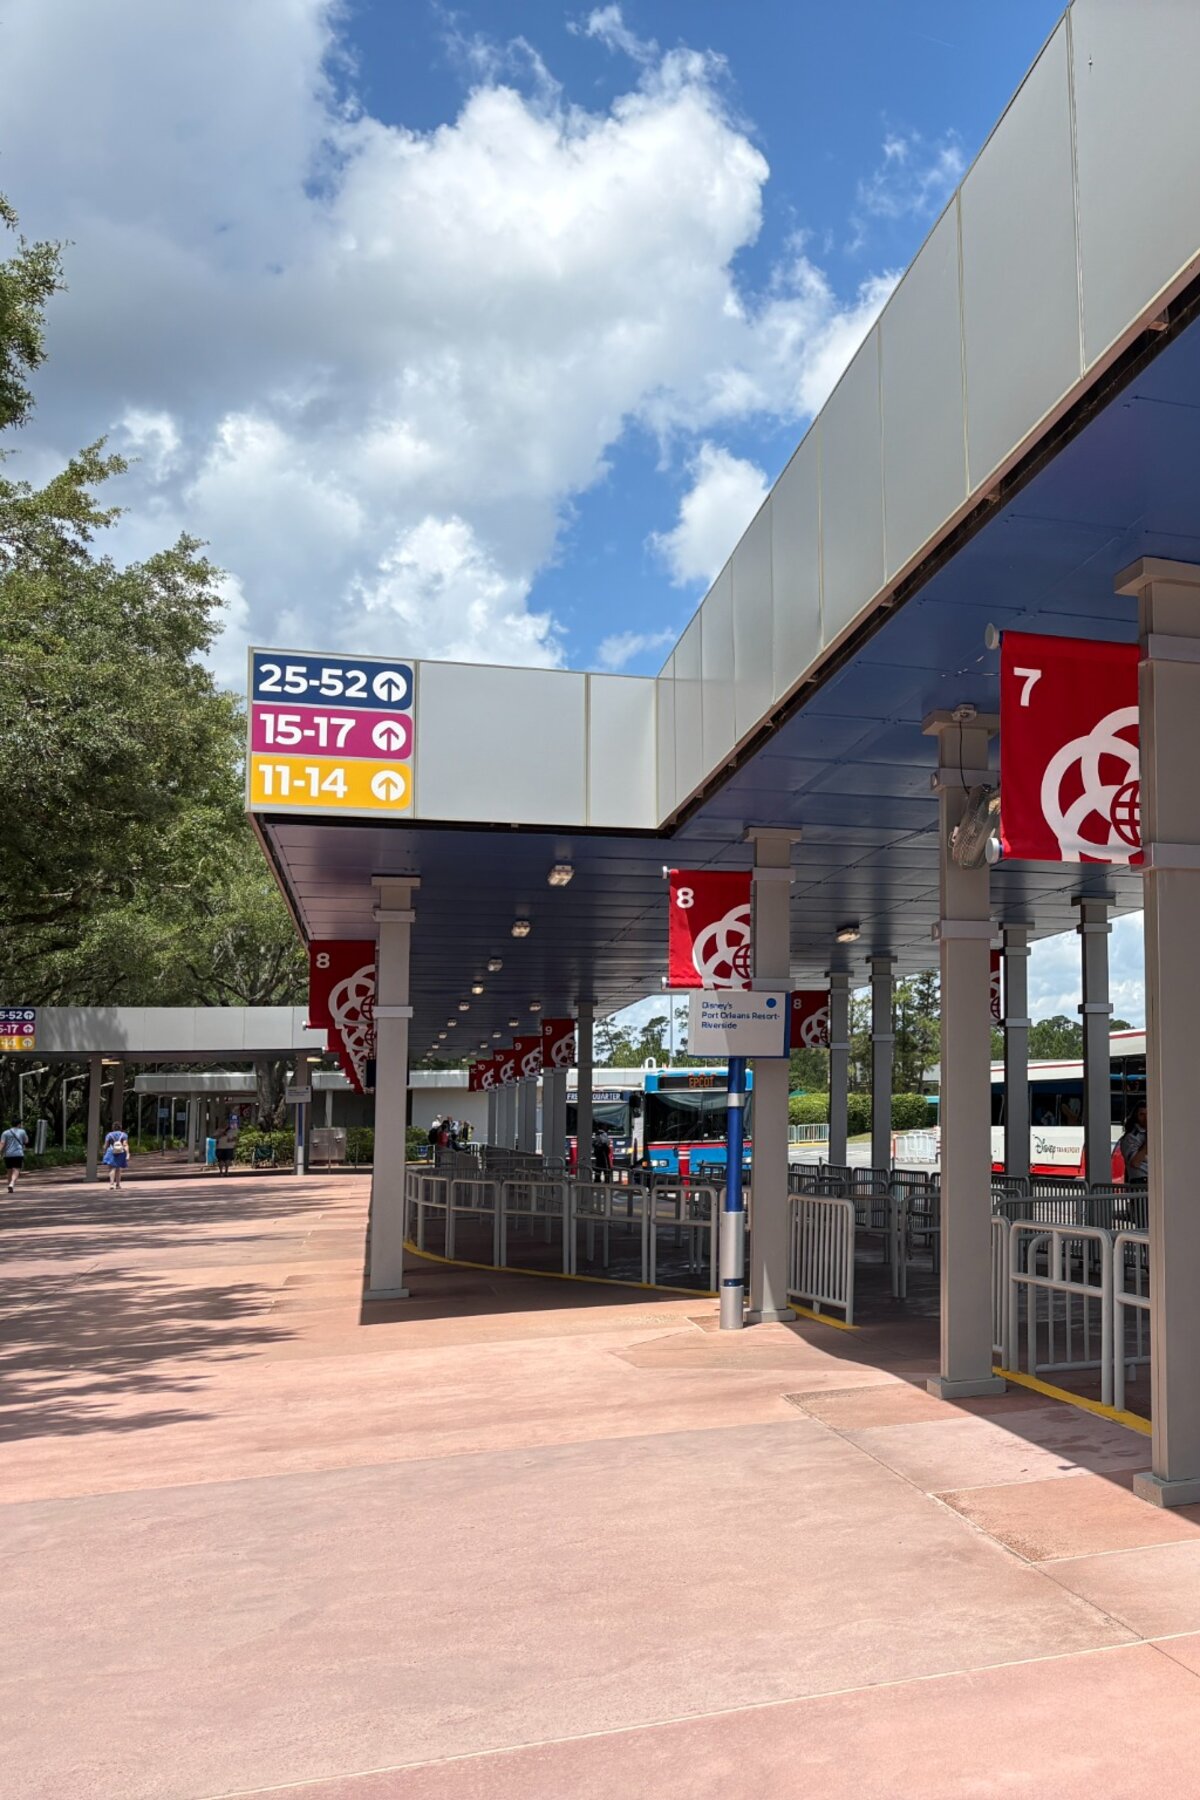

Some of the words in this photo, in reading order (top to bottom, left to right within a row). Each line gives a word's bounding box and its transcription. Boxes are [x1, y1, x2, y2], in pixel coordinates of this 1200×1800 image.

[258, 663, 368, 698] 25-52
[1013, 666, 1042, 707] 7
[259, 713, 356, 748] 15-17
[258, 764, 348, 798] 11-14
[676, 887, 695, 909] 8
[315, 952, 331, 969] 8
[702, 1001, 733, 1010] Disney's
[793, 998, 802, 1010] 8
[0, 1010, 23, 1020] 5-52
[702, 1011, 719, 1019] Port
[720, 1011, 751, 1019] Orleans
[545, 1026, 553, 1035] 9
[702, 1021, 738, 1029] Riverside
[688, 1077, 715, 1088] EPCOT
[592, 1092, 621, 1101] QUARTER
